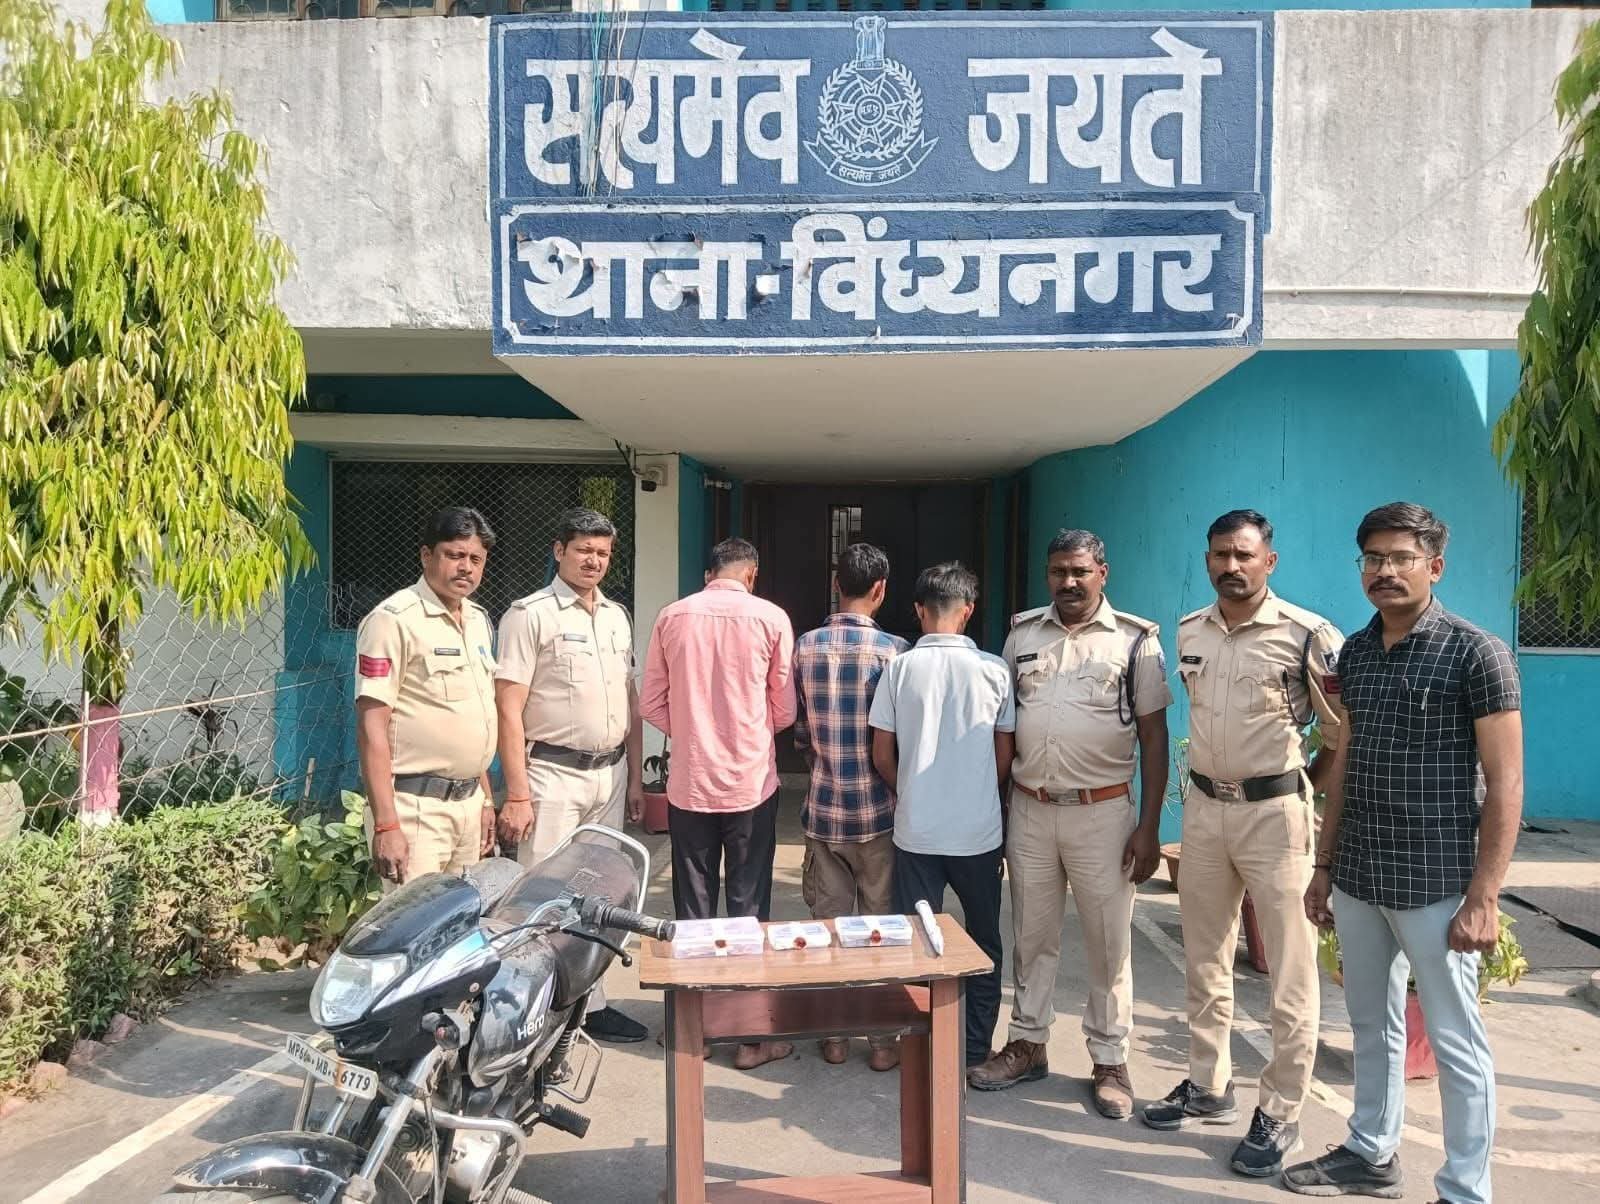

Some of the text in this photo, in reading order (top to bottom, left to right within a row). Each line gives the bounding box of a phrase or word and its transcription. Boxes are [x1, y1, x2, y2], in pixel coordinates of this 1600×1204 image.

[524, 26, 1223, 189] सत्यमेव जयते
[516, 1014, 545, 1041] Hero
[340, 1070, 371, 1092] 6779
